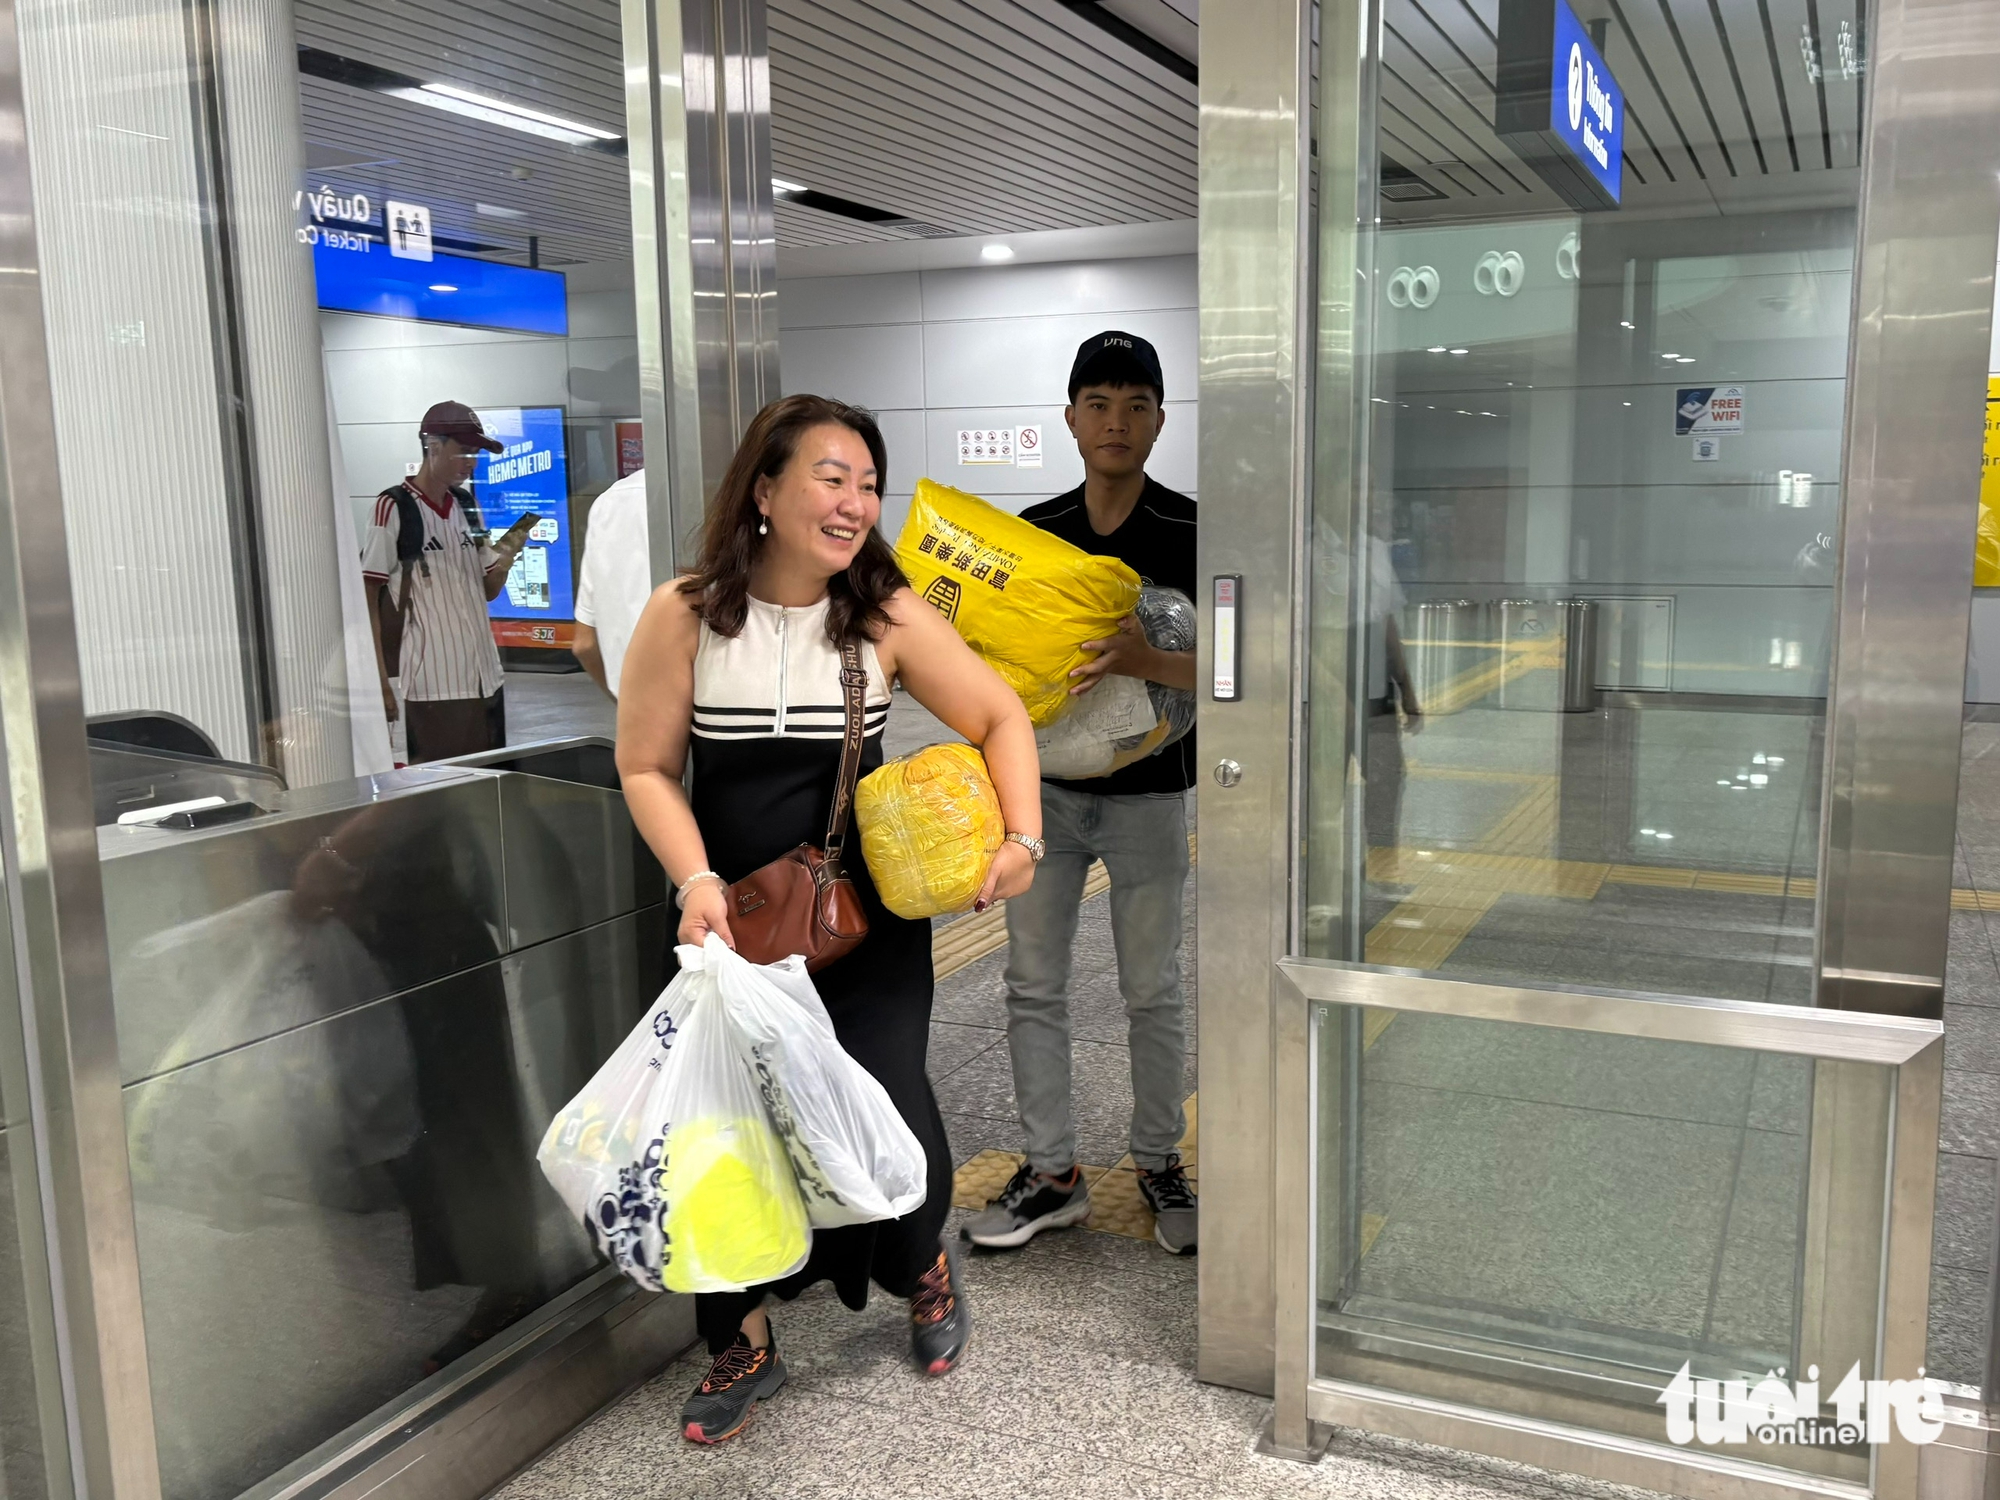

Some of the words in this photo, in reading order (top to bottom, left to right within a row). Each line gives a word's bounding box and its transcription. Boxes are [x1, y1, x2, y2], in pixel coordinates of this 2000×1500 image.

[1711, 398, 1742, 410] FREE
[1711, 410, 1740, 422] WIFI
[487, 458, 517, 485] HCMC
[517, 449, 552, 478] METRO
[918, 533, 1010, 591] 富田新樂園
[983, 550, 1018, 573] TOMITA
